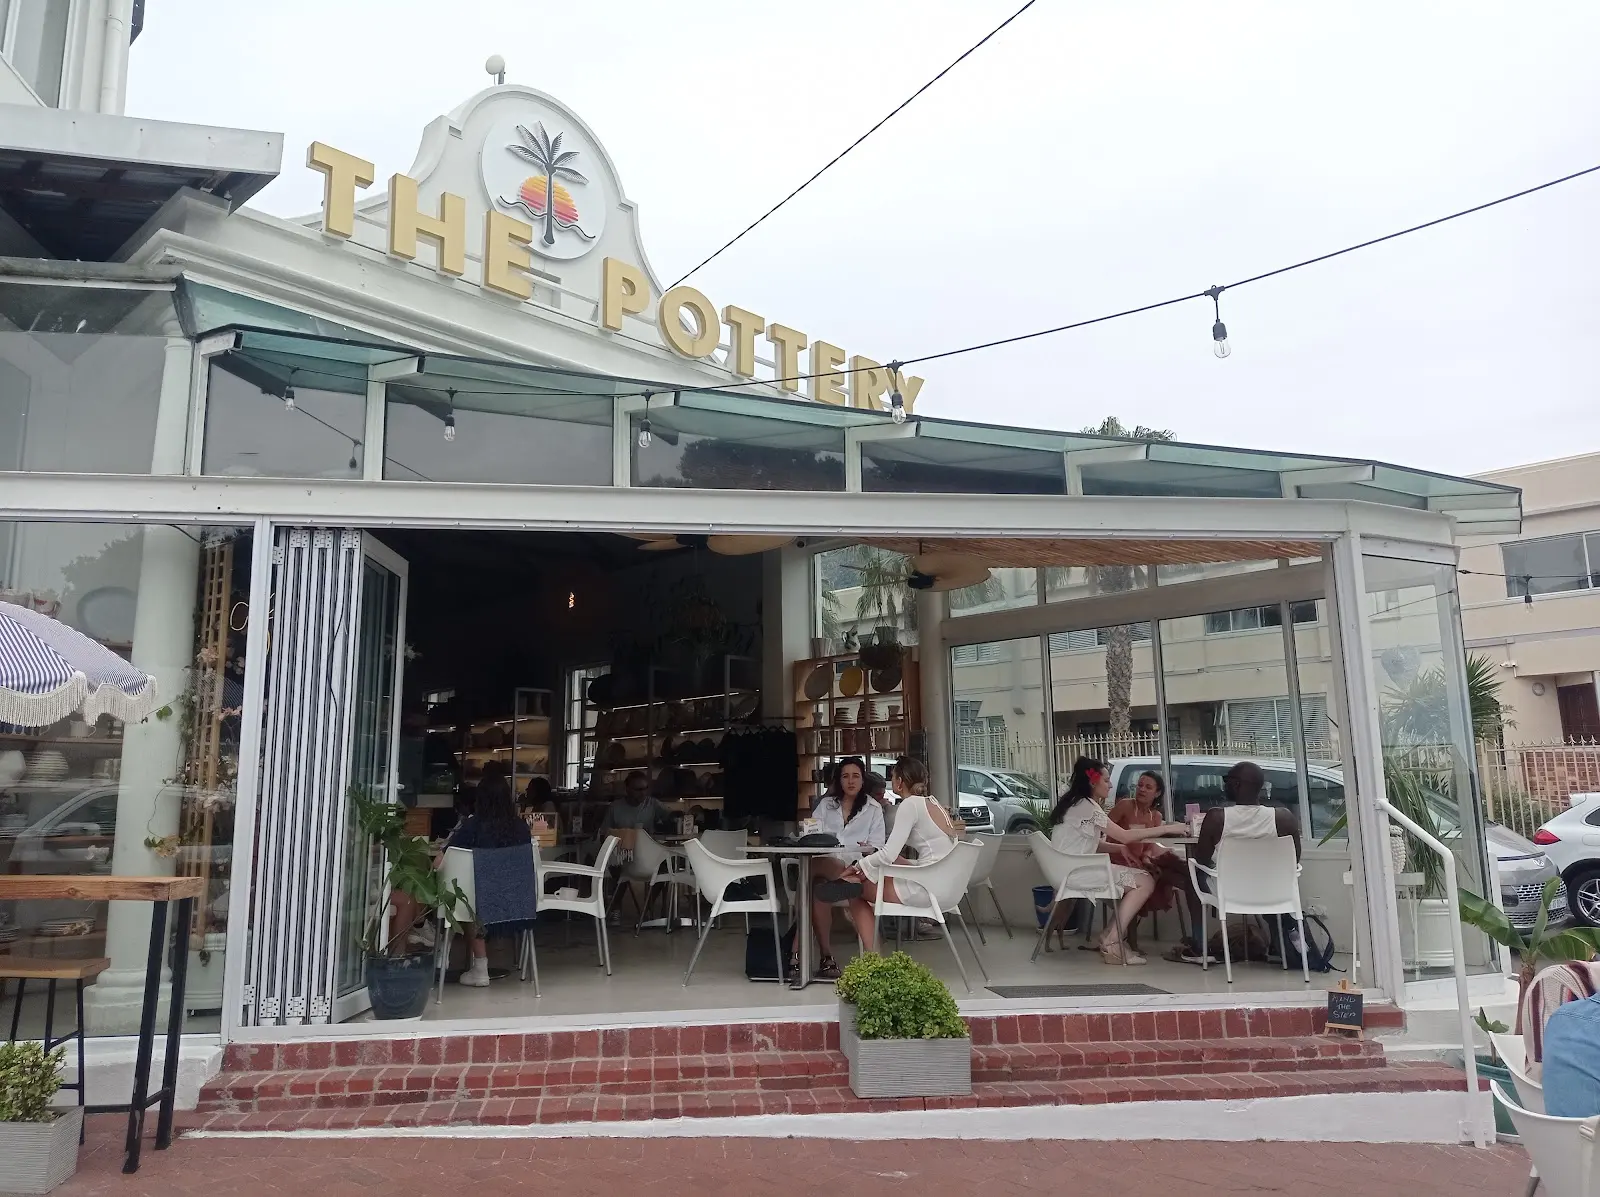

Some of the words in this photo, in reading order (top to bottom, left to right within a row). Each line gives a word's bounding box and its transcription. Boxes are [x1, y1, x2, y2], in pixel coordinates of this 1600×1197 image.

[307, 141, 533, 300] THE
[602, 256, 925, 414] POTTERY
[1332, 1010, 1356, 1018] STEP
